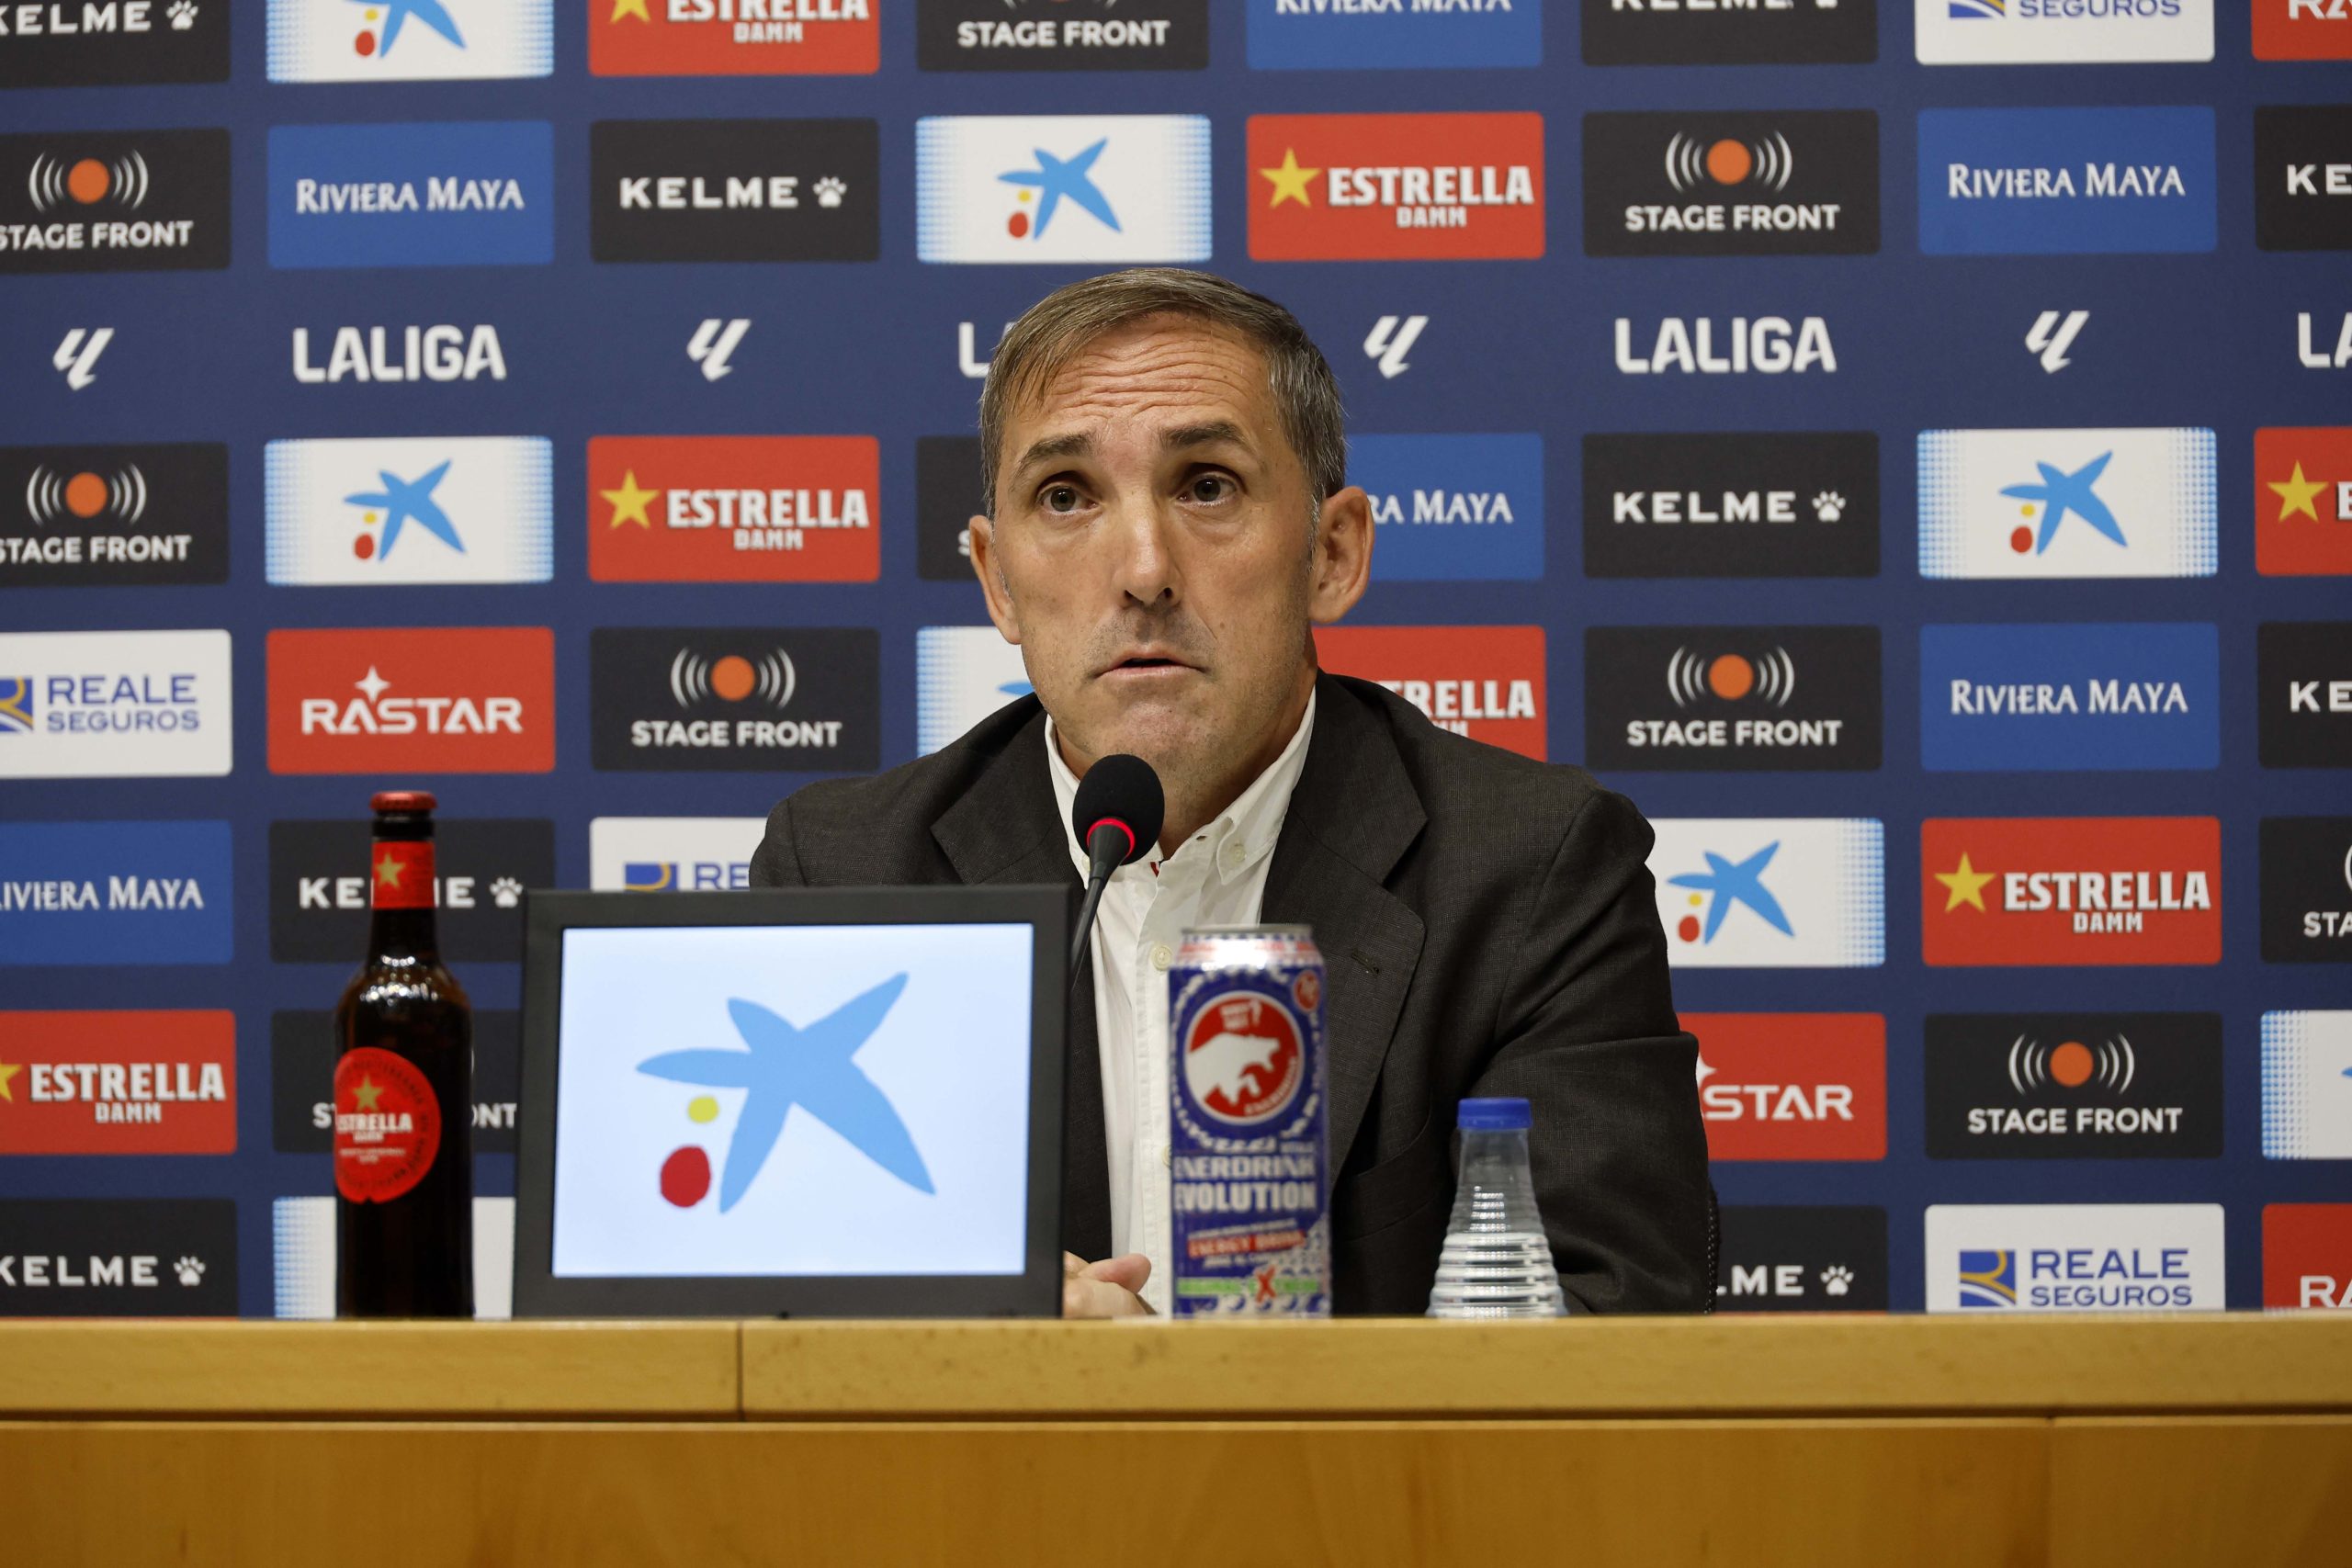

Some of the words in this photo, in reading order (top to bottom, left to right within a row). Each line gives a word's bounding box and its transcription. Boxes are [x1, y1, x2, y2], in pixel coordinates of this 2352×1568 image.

[2019, 0, 2181, 17] SEGUROS
[734, 22, 803, 42] DAMM
[957, 20, 1057, 47] STAGE
[1063, 19, 1170, 46] FRONT
[295, 178, 421, 214] RIVIERA
[426, 176, 525, 211] MAYA
[620, 176, 798, 209] KELME
[1329, 166, 1533, 205] ESTRELLA
[1949, 163, 2075, 198] RIVIERA
[2086, 163, 2186, 197] MAYA
[1396, 207, 1467, 228] DAMM
[1625, 205, 1725, 231] STAGE
[1733, 204, 1840, 231] FRONT
[92, 220, 194, 248] FRONT
[292, 324, 507, 383] LALIGA
[1615, 316, 1837, 374] LALIGA
[668, 490, 869, 527] ESTRELLA
[1413, 490, 1513, 524] MAYA
[1613, 491, 1796, 523] KELME
[0, 536, 82, 563] TAGE
[89, 535, 192, 562] FRONT
[733, 529, 804, 550] DAMM
[48, 675, 197, 705] REALE
[1951, 679, 2079, 715] RIVIERA
[2088, 679, 2188, 714] MAYA
[47, 710, 199, 732] SEGUROS
[301, 696, 523, 734] RASTAR
[631, 720, 729, 747] STAGE
[736, 720, 842, 747] FRONT
[1627, 719, 1727, 747] STAGE
[1735, 719, 1842, 746] FRONT
[0, 880, 100, 910] IVIERA
[108, 875, 204, 909] MAYA
[2005, 872, 2211, 910] ESTRELLA
[2074, 912, 2143, 932] DAMM
[31, 1064, 225, 1100] ESTRELLA
[95, 1102, 161, 1122] DAMM
[1701, 1085, 1854, 1121] STAR
[1968, 1108, 2067, 1134] STAGE
[2076, 1107, 2183, 1134] FRONT
[2030, 1248, 2190, 1280] REALE
[2030, 1285, 2192, 1307] SEGUROS
